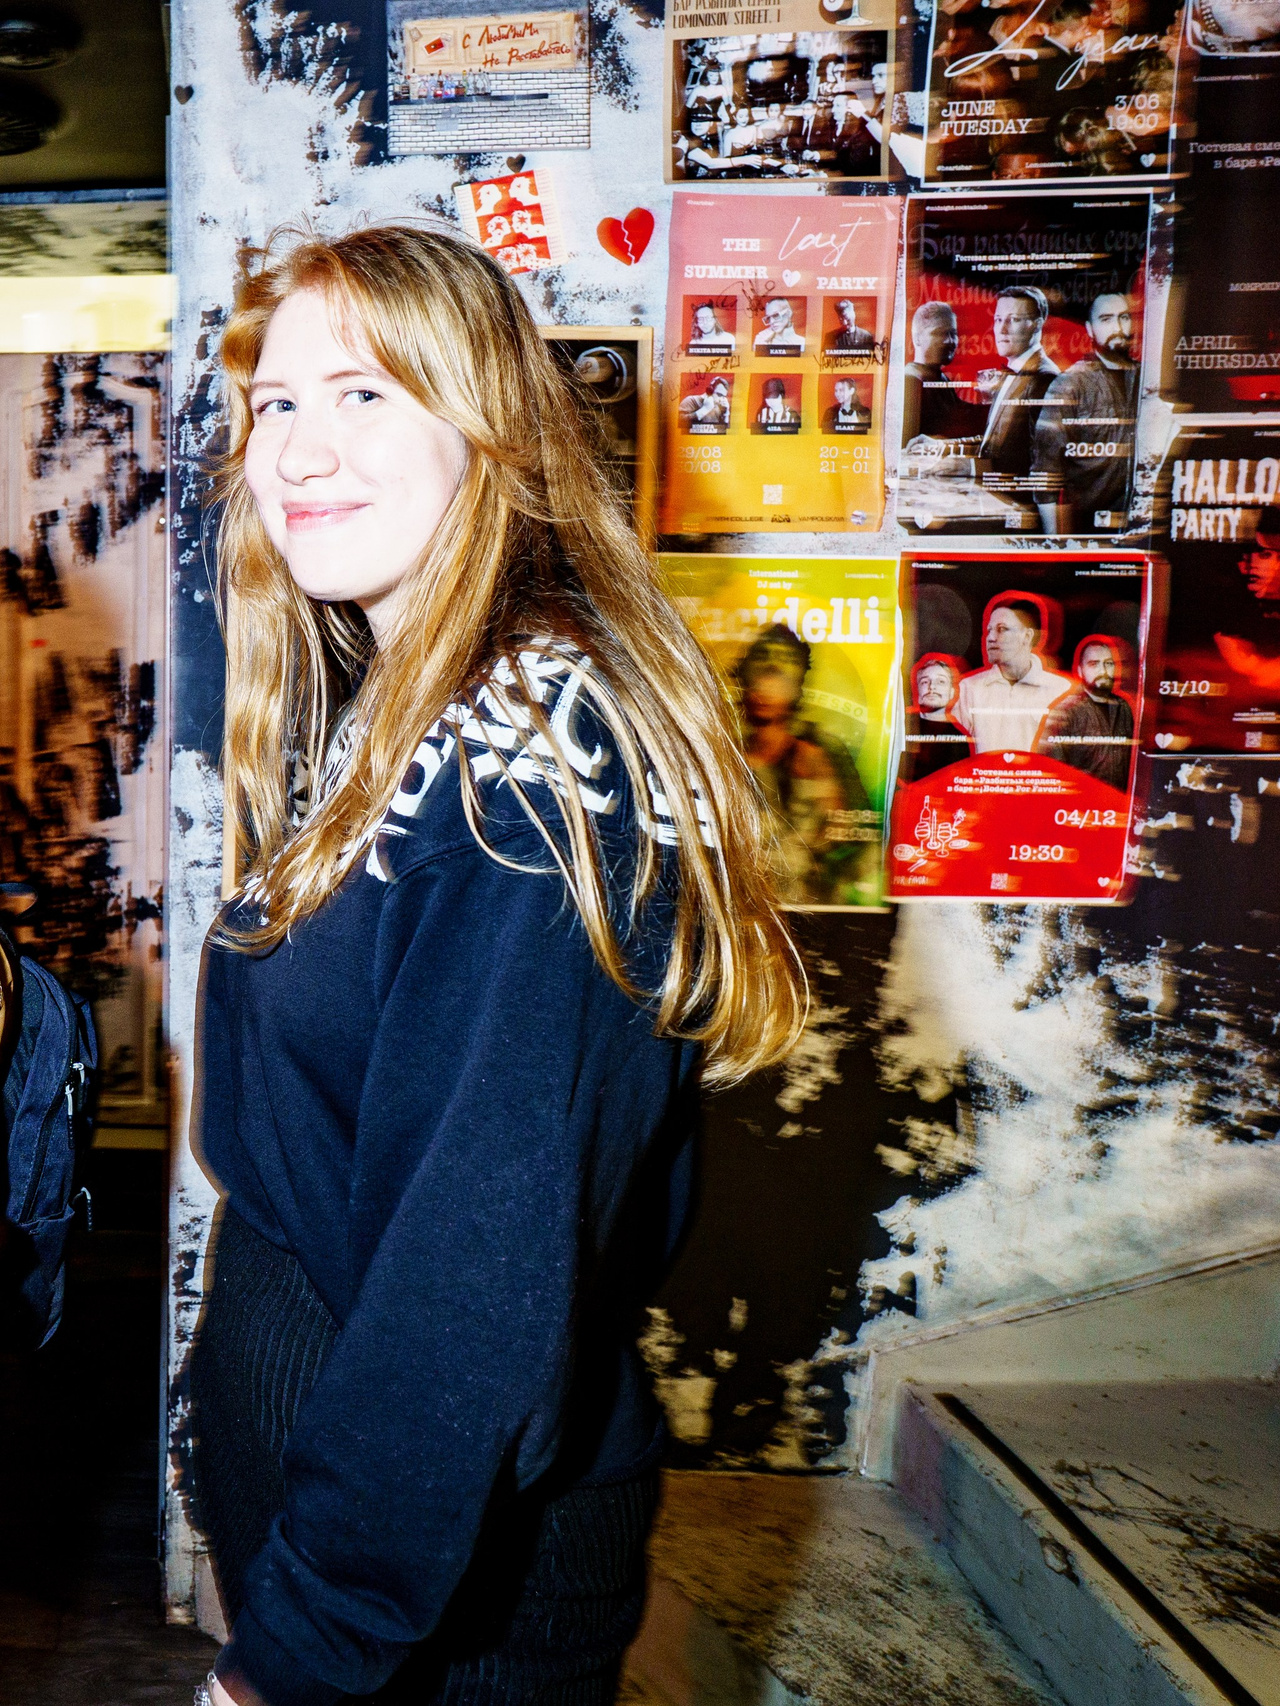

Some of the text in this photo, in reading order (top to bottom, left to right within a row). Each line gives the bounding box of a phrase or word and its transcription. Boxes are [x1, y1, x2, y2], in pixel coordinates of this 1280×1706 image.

[673, 12, 728, 28] LOMONOSOV
[941, 100, 995, 117] JUNE
[1114, 94, 1160, 111] 3/06
[940, 118, 1032, 136] TUESDAY
[1107, 114, 1160, 131] 19:00
[1189, 142, 1252, 154] Гостевая
[1224, 156, 1257, 170] баре
[722, 238, 760, 252] THE
[684, 266, 768, 279] SUMMER
[816, 277, 878, 290] PARTY
[1174, 336, 1236, 350] APRIL
[1174, 353, 1280, 370] THURSDAY
[820, 446, 838, 458] 20
[853, 446, 870, 459] 01
[1065, 442, 1116, 458] 20:00
[820, 460, 836, 473] 21
[852, 461, 869, 474] 01
[1171, 507, 1242, 543] PARTY
[749, 570, 799, 578] International
[757, 581, 767, 589] DJ
[782, 581, 792, 590] by
[1159, 680, 1210, 698] 31/10
[954, 776, 973, 784] бара
[954, 784, 973, 793] баре
[1054, 809, 1116, 829] 04/12
[1008, 844, 1064, 861] 19:30
